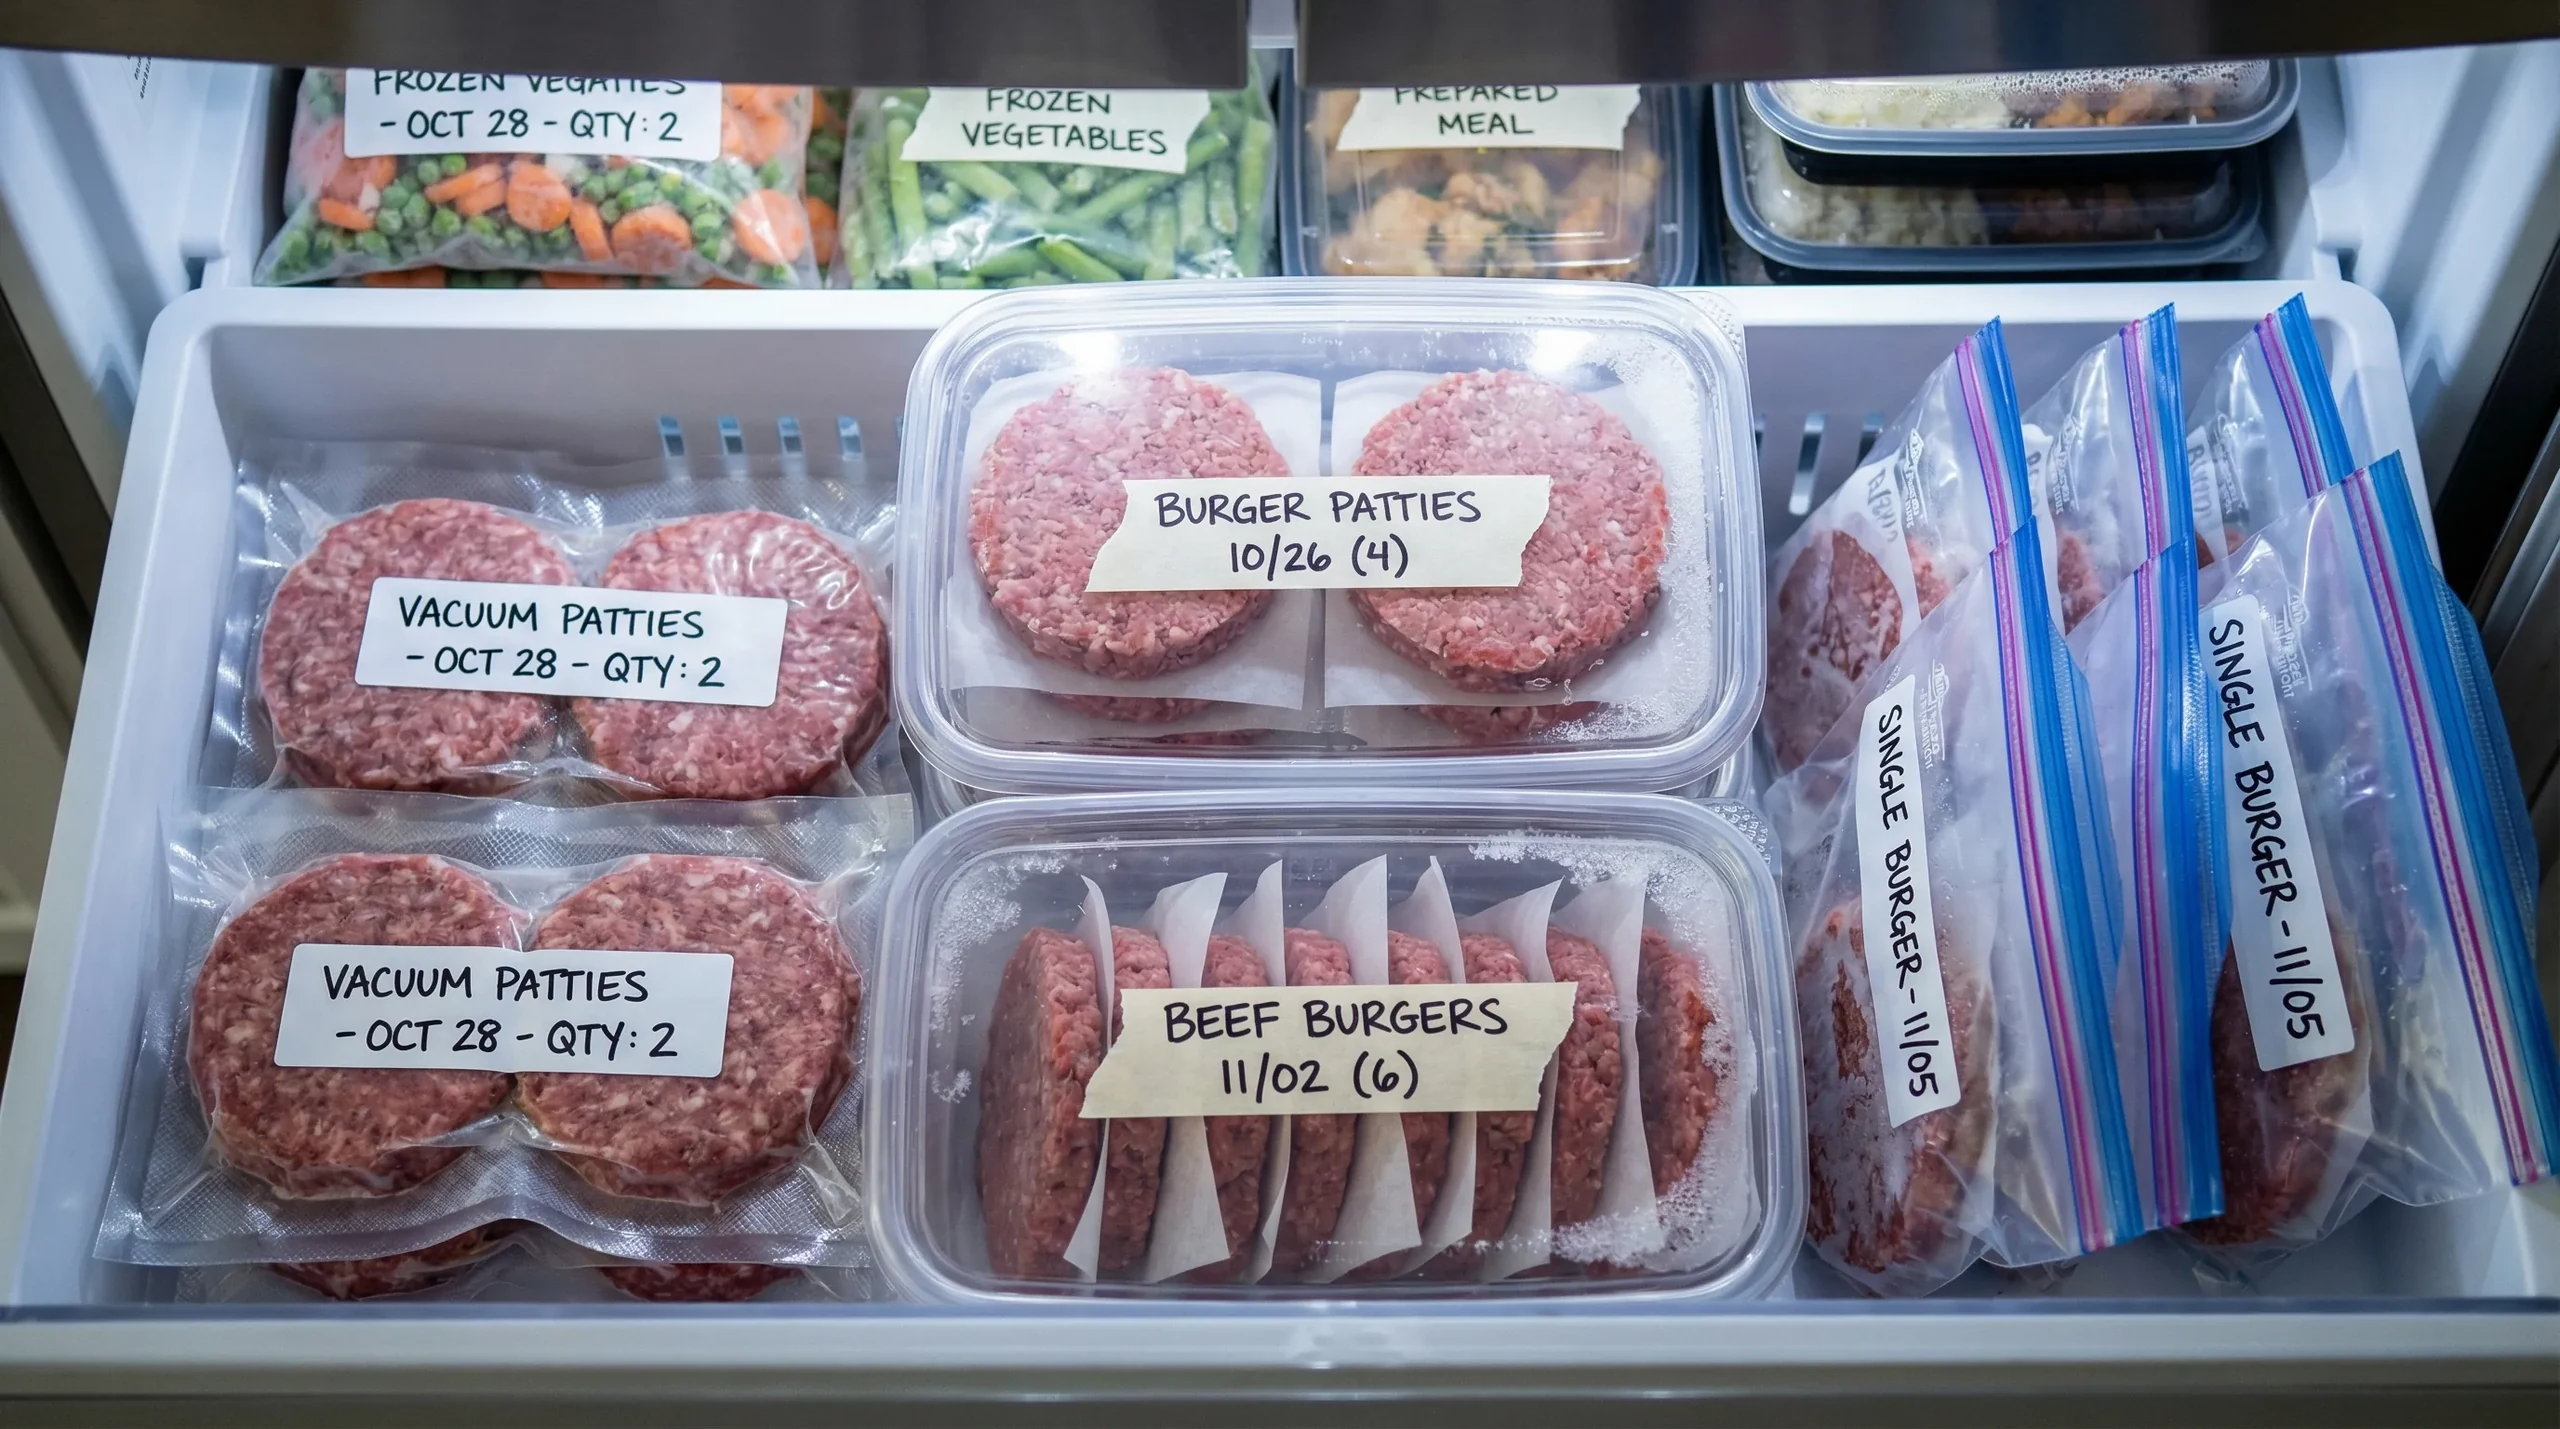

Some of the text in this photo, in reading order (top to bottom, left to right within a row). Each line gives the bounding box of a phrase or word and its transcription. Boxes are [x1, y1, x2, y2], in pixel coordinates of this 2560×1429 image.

[373, 70, 506, 96] FROZEN
[986, 88, 1111, 114] FROZEN
[1394, 86, 1558, 105] PREPARED
[406, 110, 474, 140] OCT
[486, 108, 529, 138] 28
[569, 109, 648, 142] QTY:
[658, 111, 683, 142] 2
[961, 121, 1167, 155] VEGETABLES
[1438, 112, 1534, 135] MEAL
[1153, 490, 1482, 528] BURGER PATTIES
[1230, 533, 1409, 582] 10/26 (4)
[398, 594, 704, 639] VACUUM PATTIES
[434, 646, 504, 676] OCT
[512, 647, 557, 680] 28
[603, 651, 687, 689] QTY:
[697, 656, 725, 688] 2
[2209, 618, 2265, 749] SINGLE
[1878, 704, 1909, 831] SINGLE
[323, 963, 649, 1003] VACUUM PATTIES
[366, 1019, 443, 1052] OCT
[451, 1018, 502, 1053] 28
[547, 1019, 638, 1062] QTY:
[648, 1022, 678, 1058] 2
[1163, 997, 1508, 1044] BEEF BURGERS
[1221, 1049, 1419, 1104] 11/02 (6)
